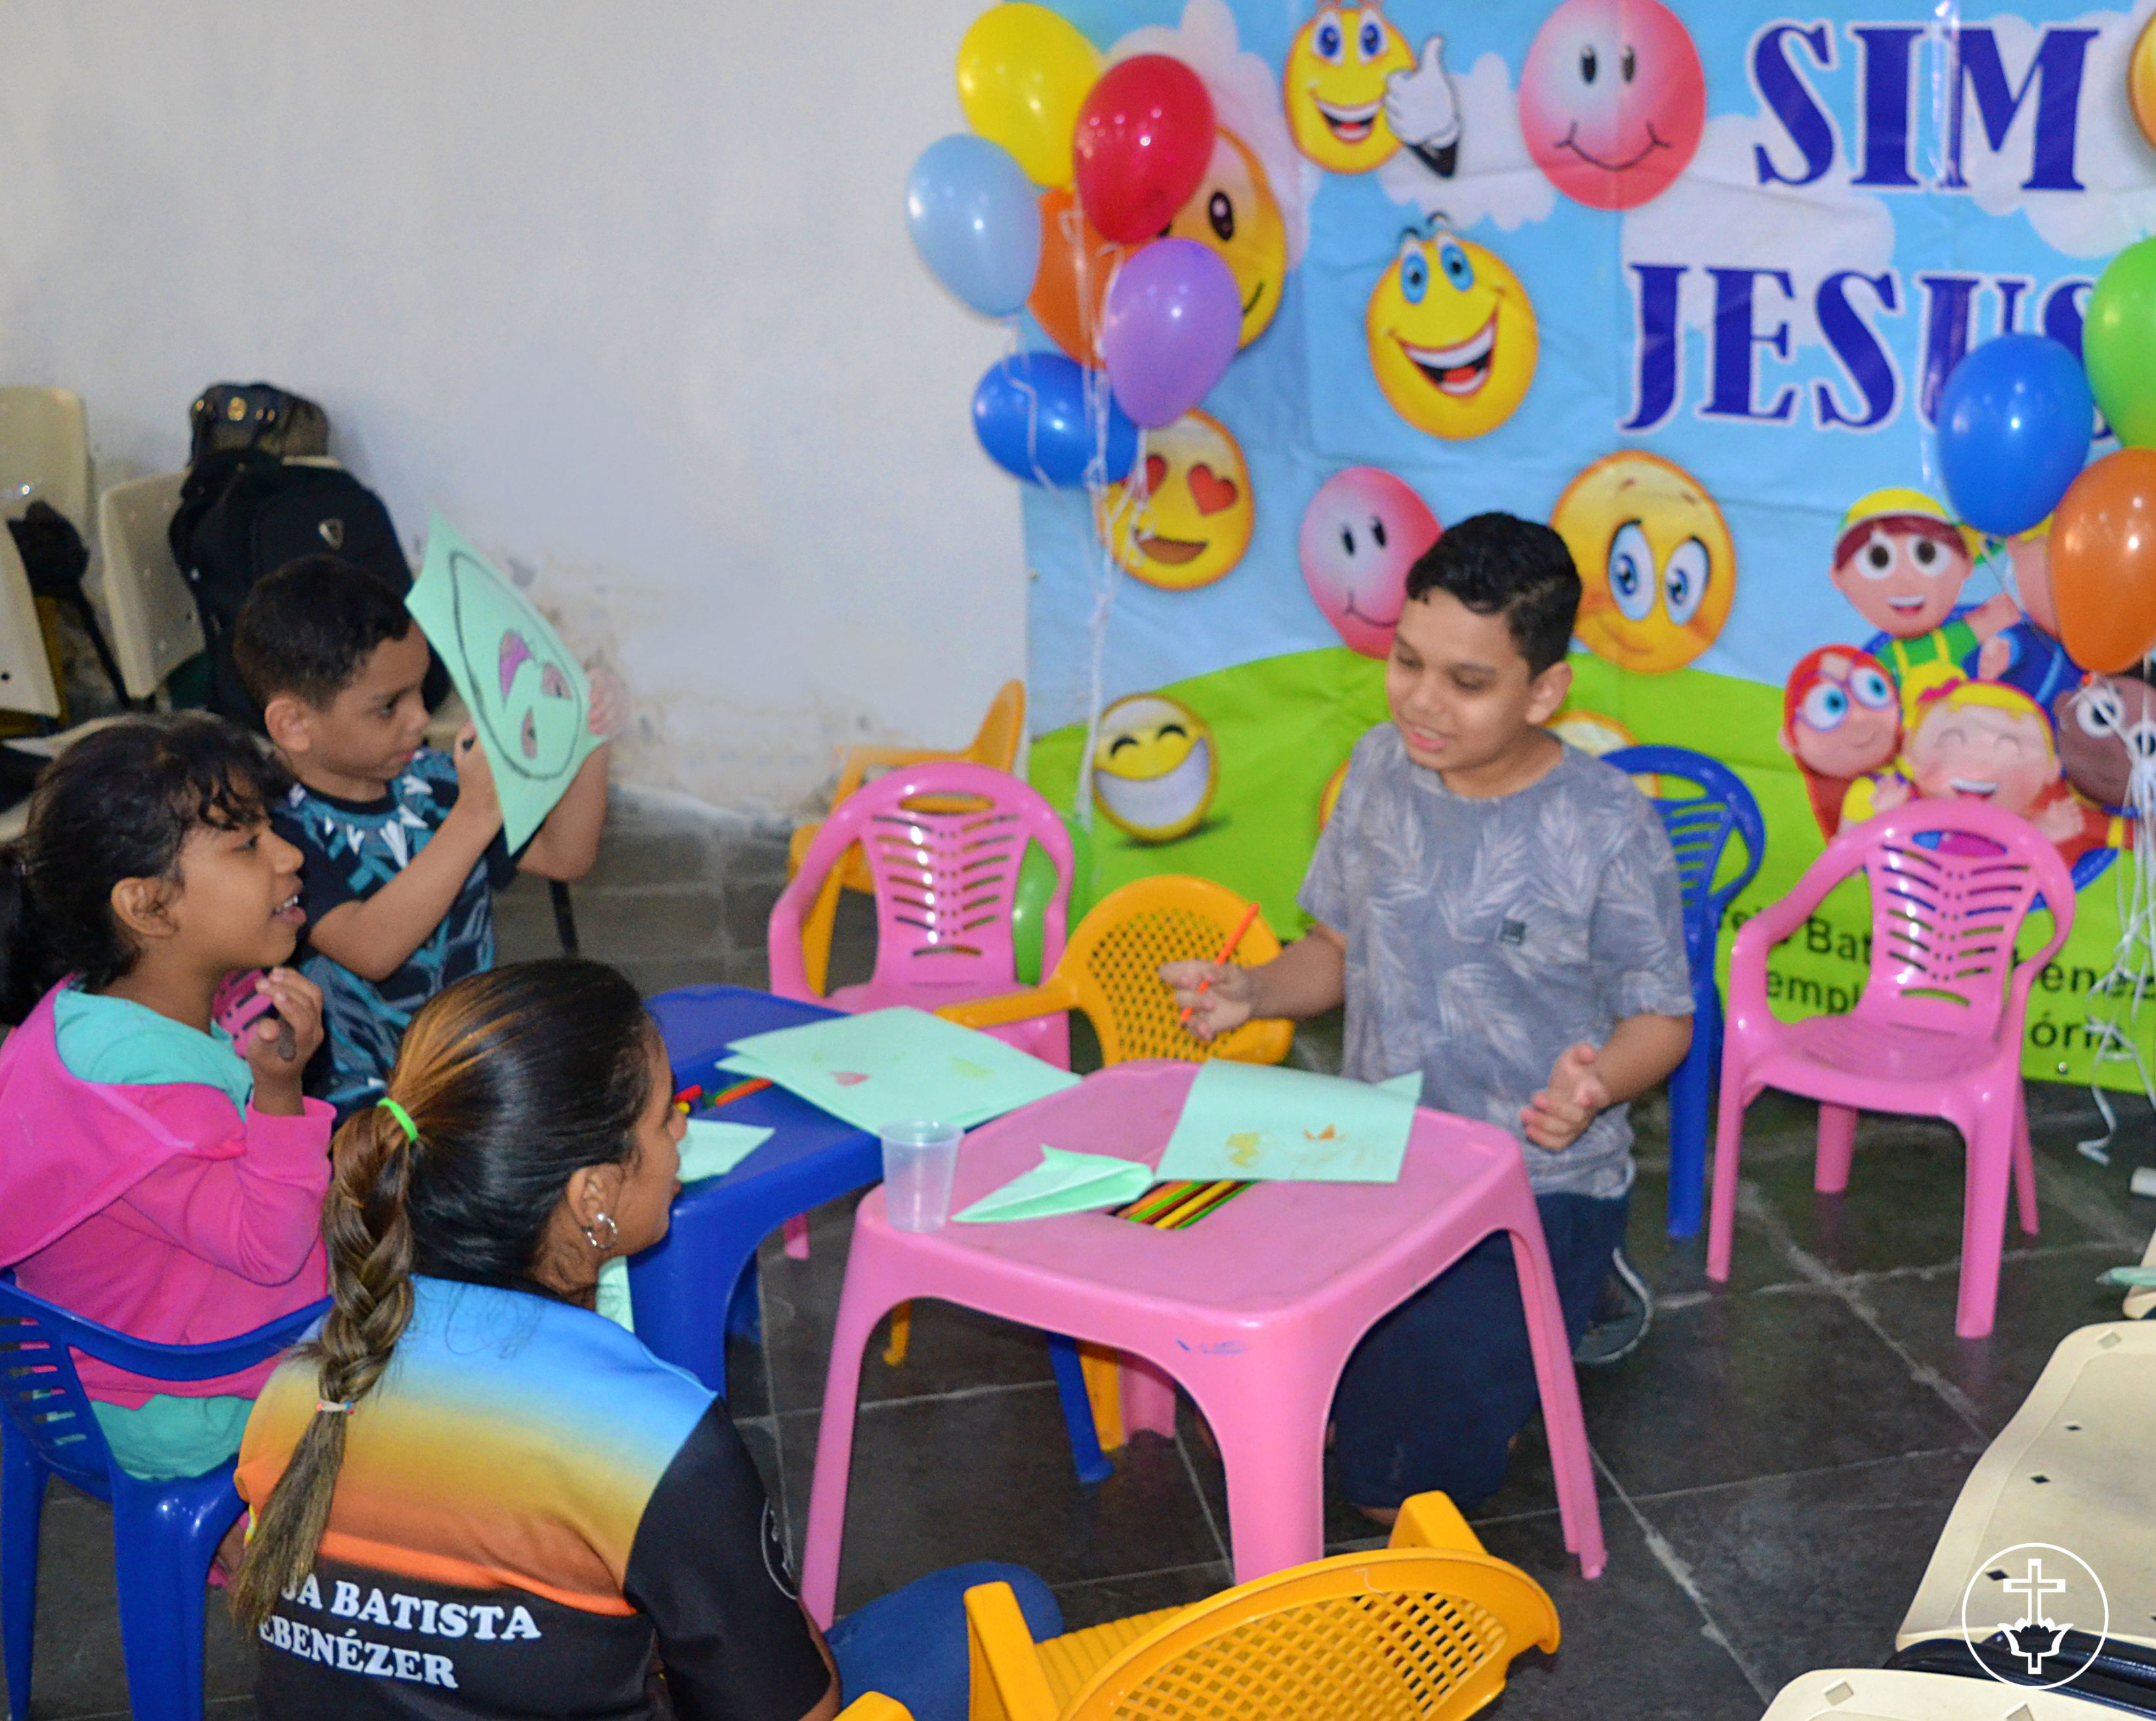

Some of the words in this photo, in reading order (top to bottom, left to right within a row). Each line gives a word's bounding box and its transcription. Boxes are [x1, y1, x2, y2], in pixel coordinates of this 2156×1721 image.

[1751, 24, 2102, 192] SIM
[330, 1580, 542, 1640] BATISTA
[259, 1614, 458, 1688] EBENÉZER
